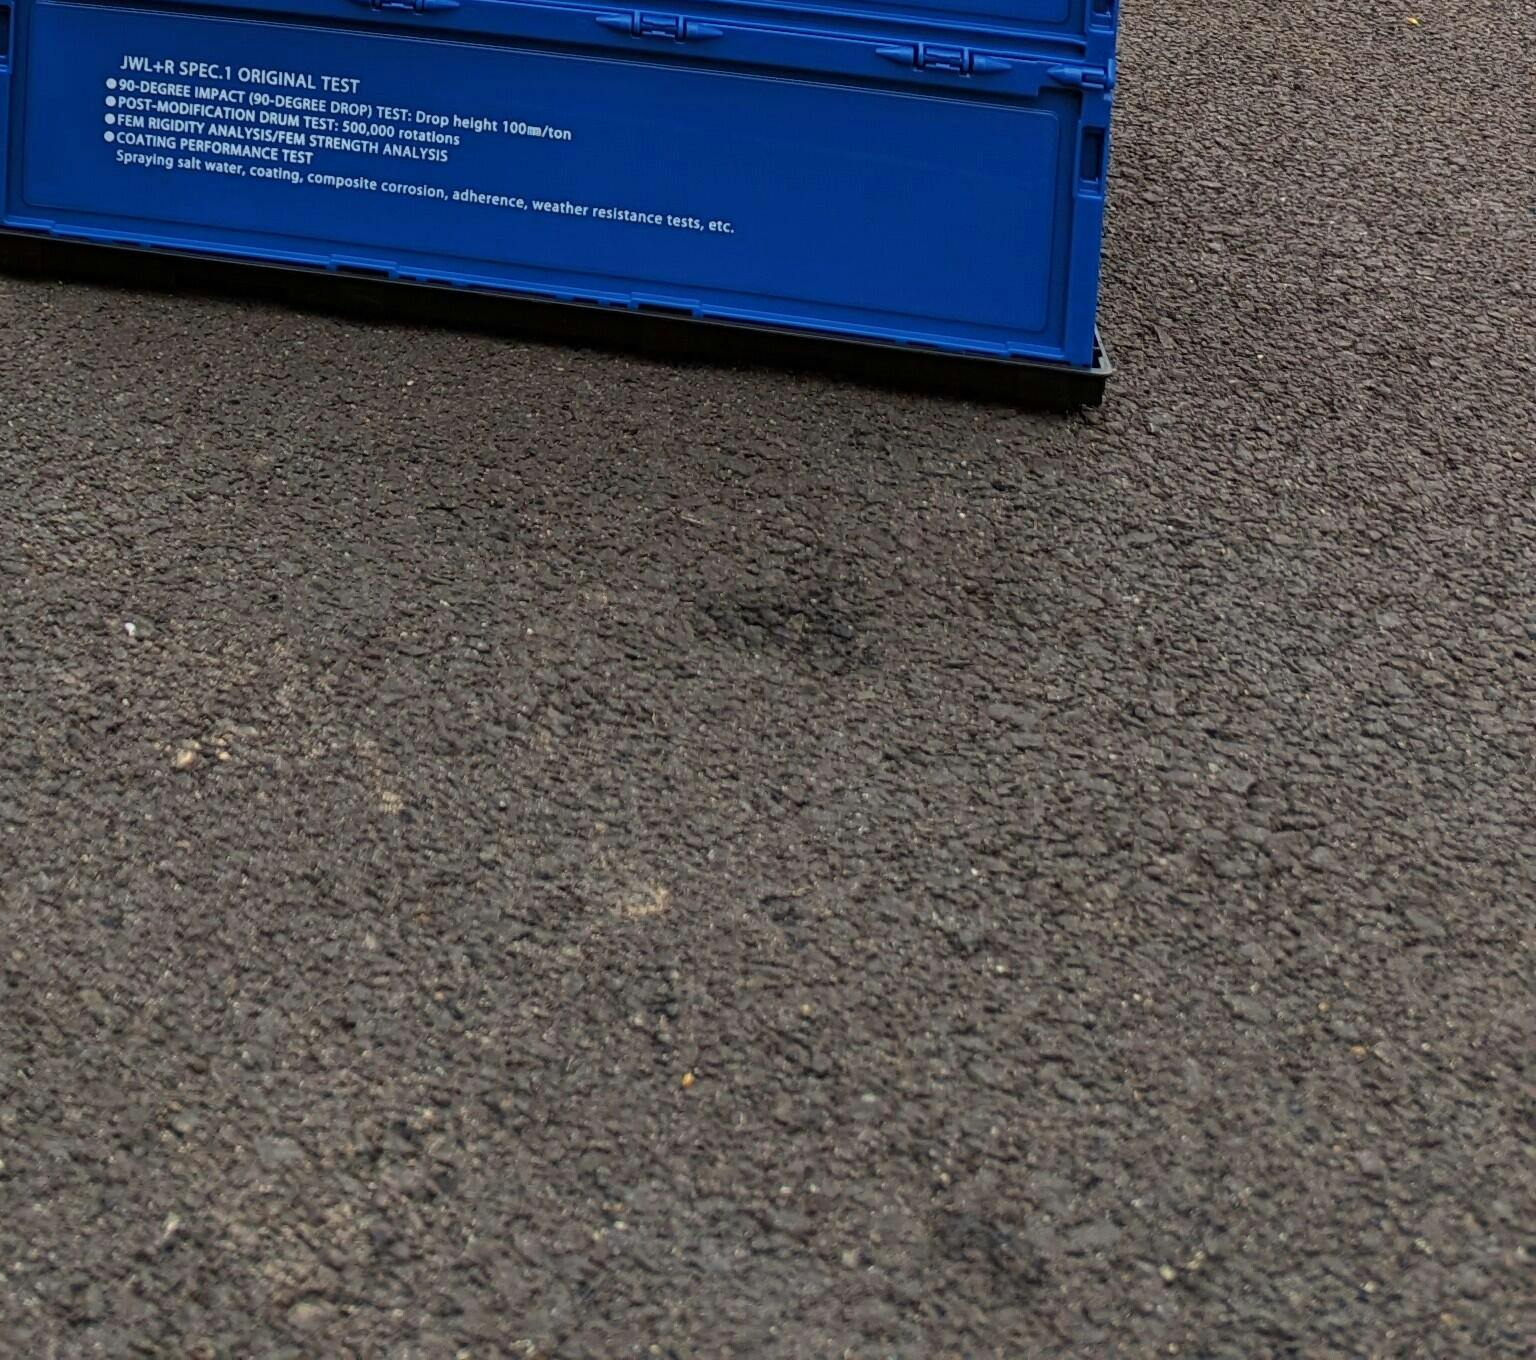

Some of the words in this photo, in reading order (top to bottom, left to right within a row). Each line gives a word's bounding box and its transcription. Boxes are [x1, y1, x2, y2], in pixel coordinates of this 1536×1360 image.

[120, 55, 175, 75] JWL+R
[179, 61, 231, 80] SPEC.1
[237, 67, 316, 90] ORIGINAL
[321, 75, 360, 94] TEST
[118, 96, 256, 122] POST-MODIFICATION
[260, 111, 300, 127] DRUM
[303, 116, 339, 131] TEST:
[342, 121, 395, 138] 500,000
[399, 129, 460, 146] rotations
[119, 78, 191, 98] 90-DEGREE
[194, 86, 245, 103] IMPACT
[249, 91, 327, 112] (90-DEGREE
[331, 101, 373, 118] DROP)
[376, 106, 412, 122] TEST:
[416, 110, 449, 127] Drop
[453, 114, 498, 133] height
[116, 131, 176, 149] COATING
[180, 137, 278, 161] PERFORMANCE
[282, 148, 313, 164] TEST
[117, 114, 145, 128] FEM
[148, 117, 205, 134] RIGIDITY
[208, 123, 305, 146] ANALYSIS/FEM
[309, 135, 379, 154] STRENGTH
[382, 143, 448, 162] ANALYSIS
[116, 149, 173, 169] Spraying
[177, 156, 201, 170] salt
[205, 161, 246, 176] water,
[249, 166, 304, 183] coating,
[307, 172, 377, 190] composite
[381, 181, 449, 201] corrosion,
[452, 188, 528, 211] adherence,
[532, 199, 588, 217] weather
[592, 207, 663, 225] resistance
[667, 214, 704, 231] tests,
[708, 220, 735, 234] etc.
